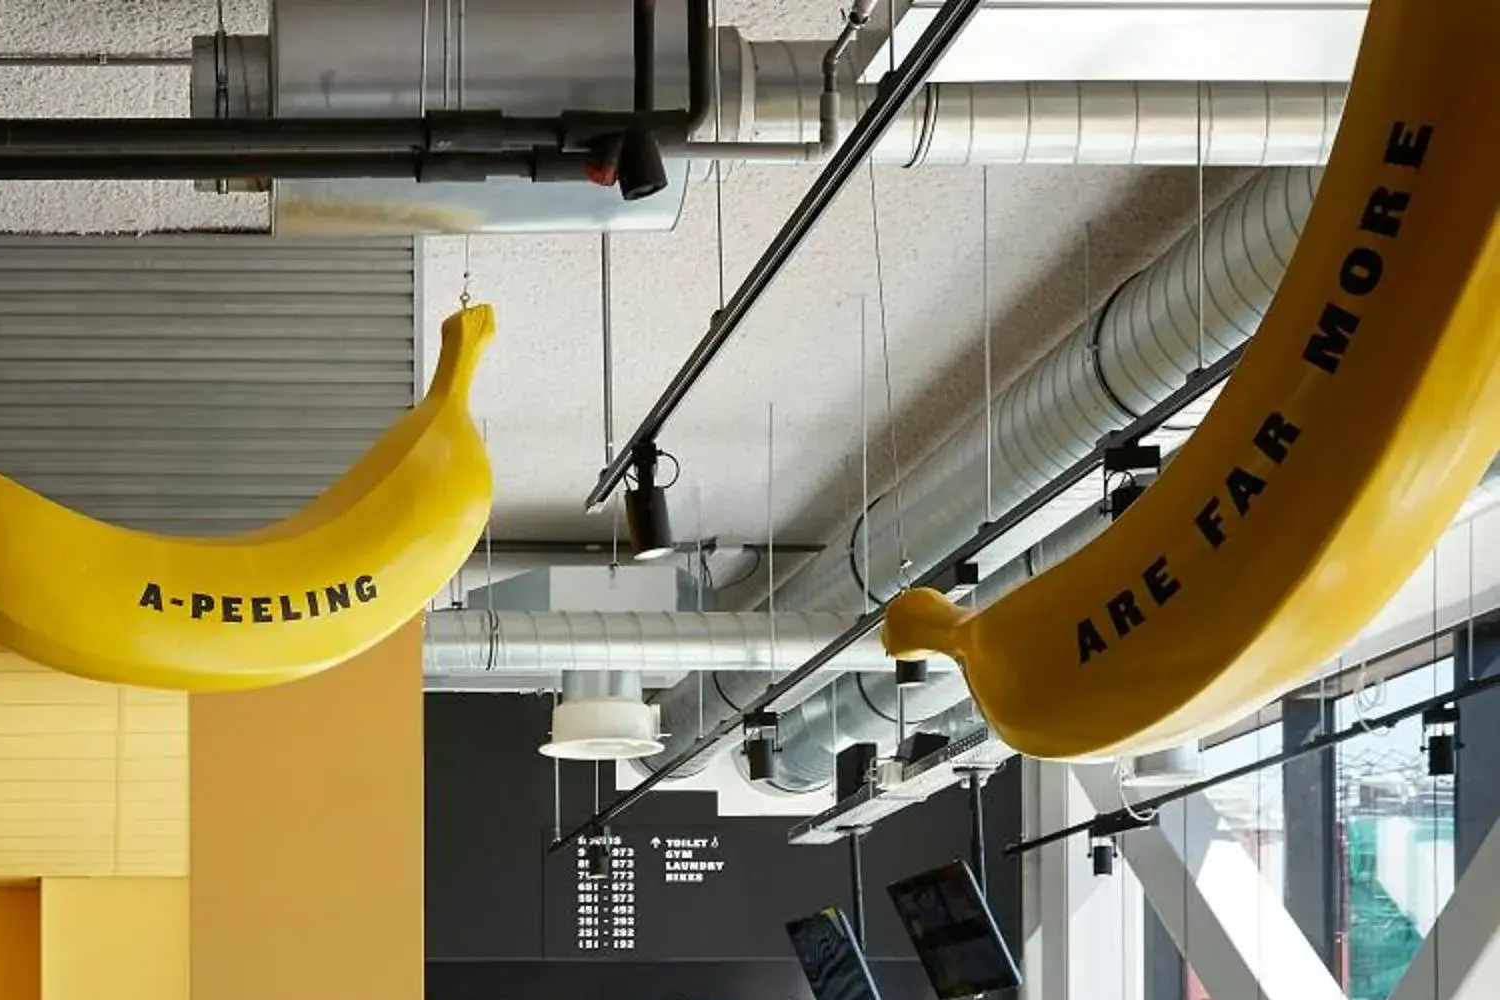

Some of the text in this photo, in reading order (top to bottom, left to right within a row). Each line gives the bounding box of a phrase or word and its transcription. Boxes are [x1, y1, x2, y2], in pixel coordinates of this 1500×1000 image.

[1076, 120, 1434, 665] ARE FAR MORE
[138, 574, 378, 624] A-PEELING
[665, 838, 709, 848] TOILET
[665, 849, 693, 859] GYM
[665, 861, 725, 871] LAUNDRY
[665, 872, 704, 883] BIKES
